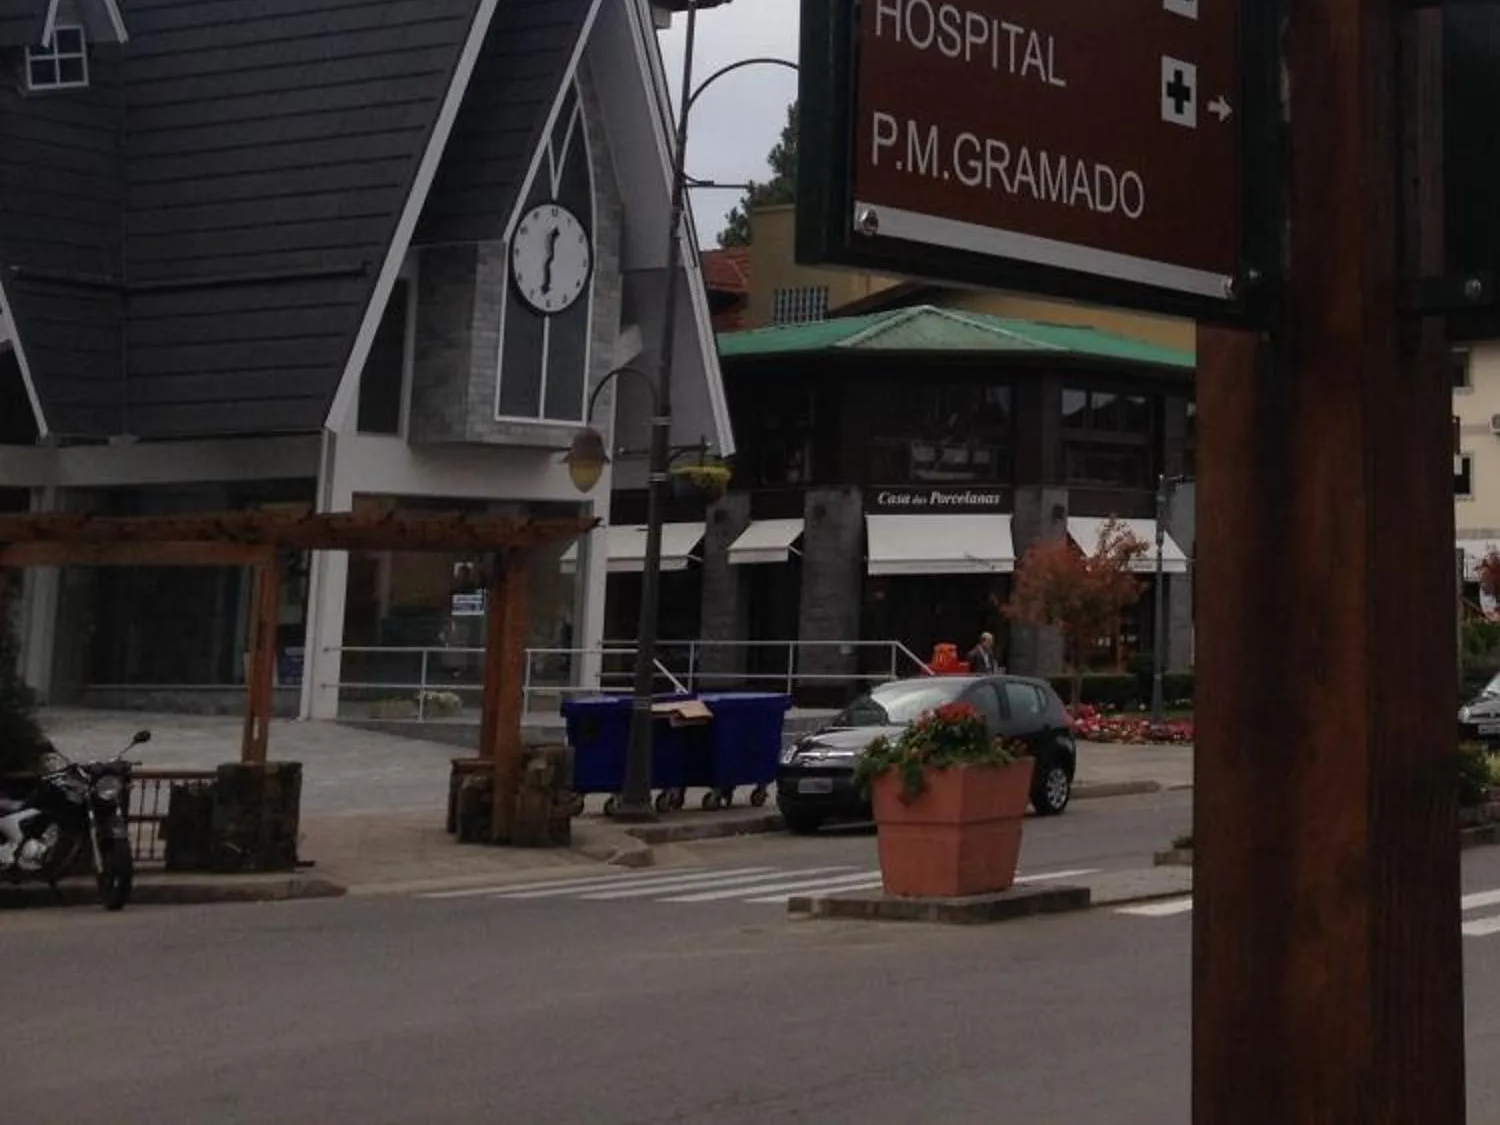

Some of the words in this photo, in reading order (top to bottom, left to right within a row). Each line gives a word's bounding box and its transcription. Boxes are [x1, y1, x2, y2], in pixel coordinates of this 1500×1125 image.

[872, 112, 1145, 219] P.M.GRAMADO
[878, 491, 911, 505] Casa
[929, 490, 1000, 505] Porcelanas
